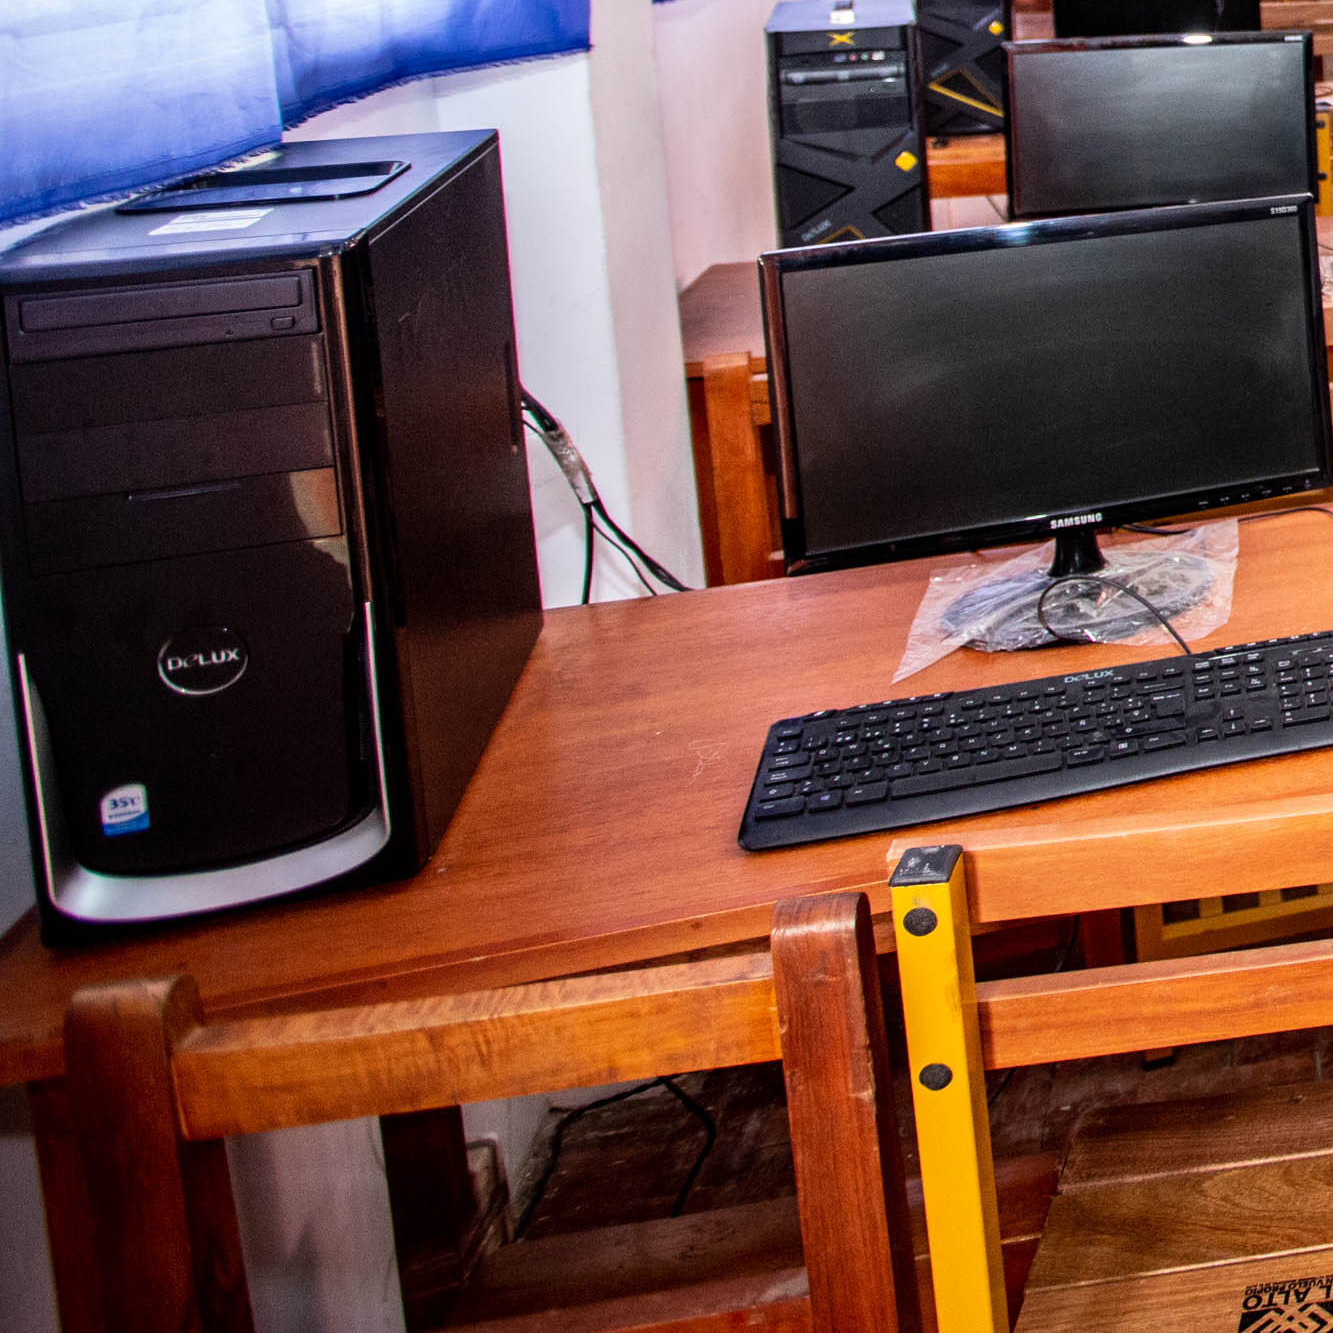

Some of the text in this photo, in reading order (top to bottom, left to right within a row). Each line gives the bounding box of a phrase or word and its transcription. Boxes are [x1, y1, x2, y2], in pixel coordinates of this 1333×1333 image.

[1050, 513, 1102, 530] SAMSUNG
[1244, 1283, 1286, 1296] PROPIO
[1288, 1277, 1324, 1289] VUELO
[1242, 1287, 1311, 1310] ALTO
